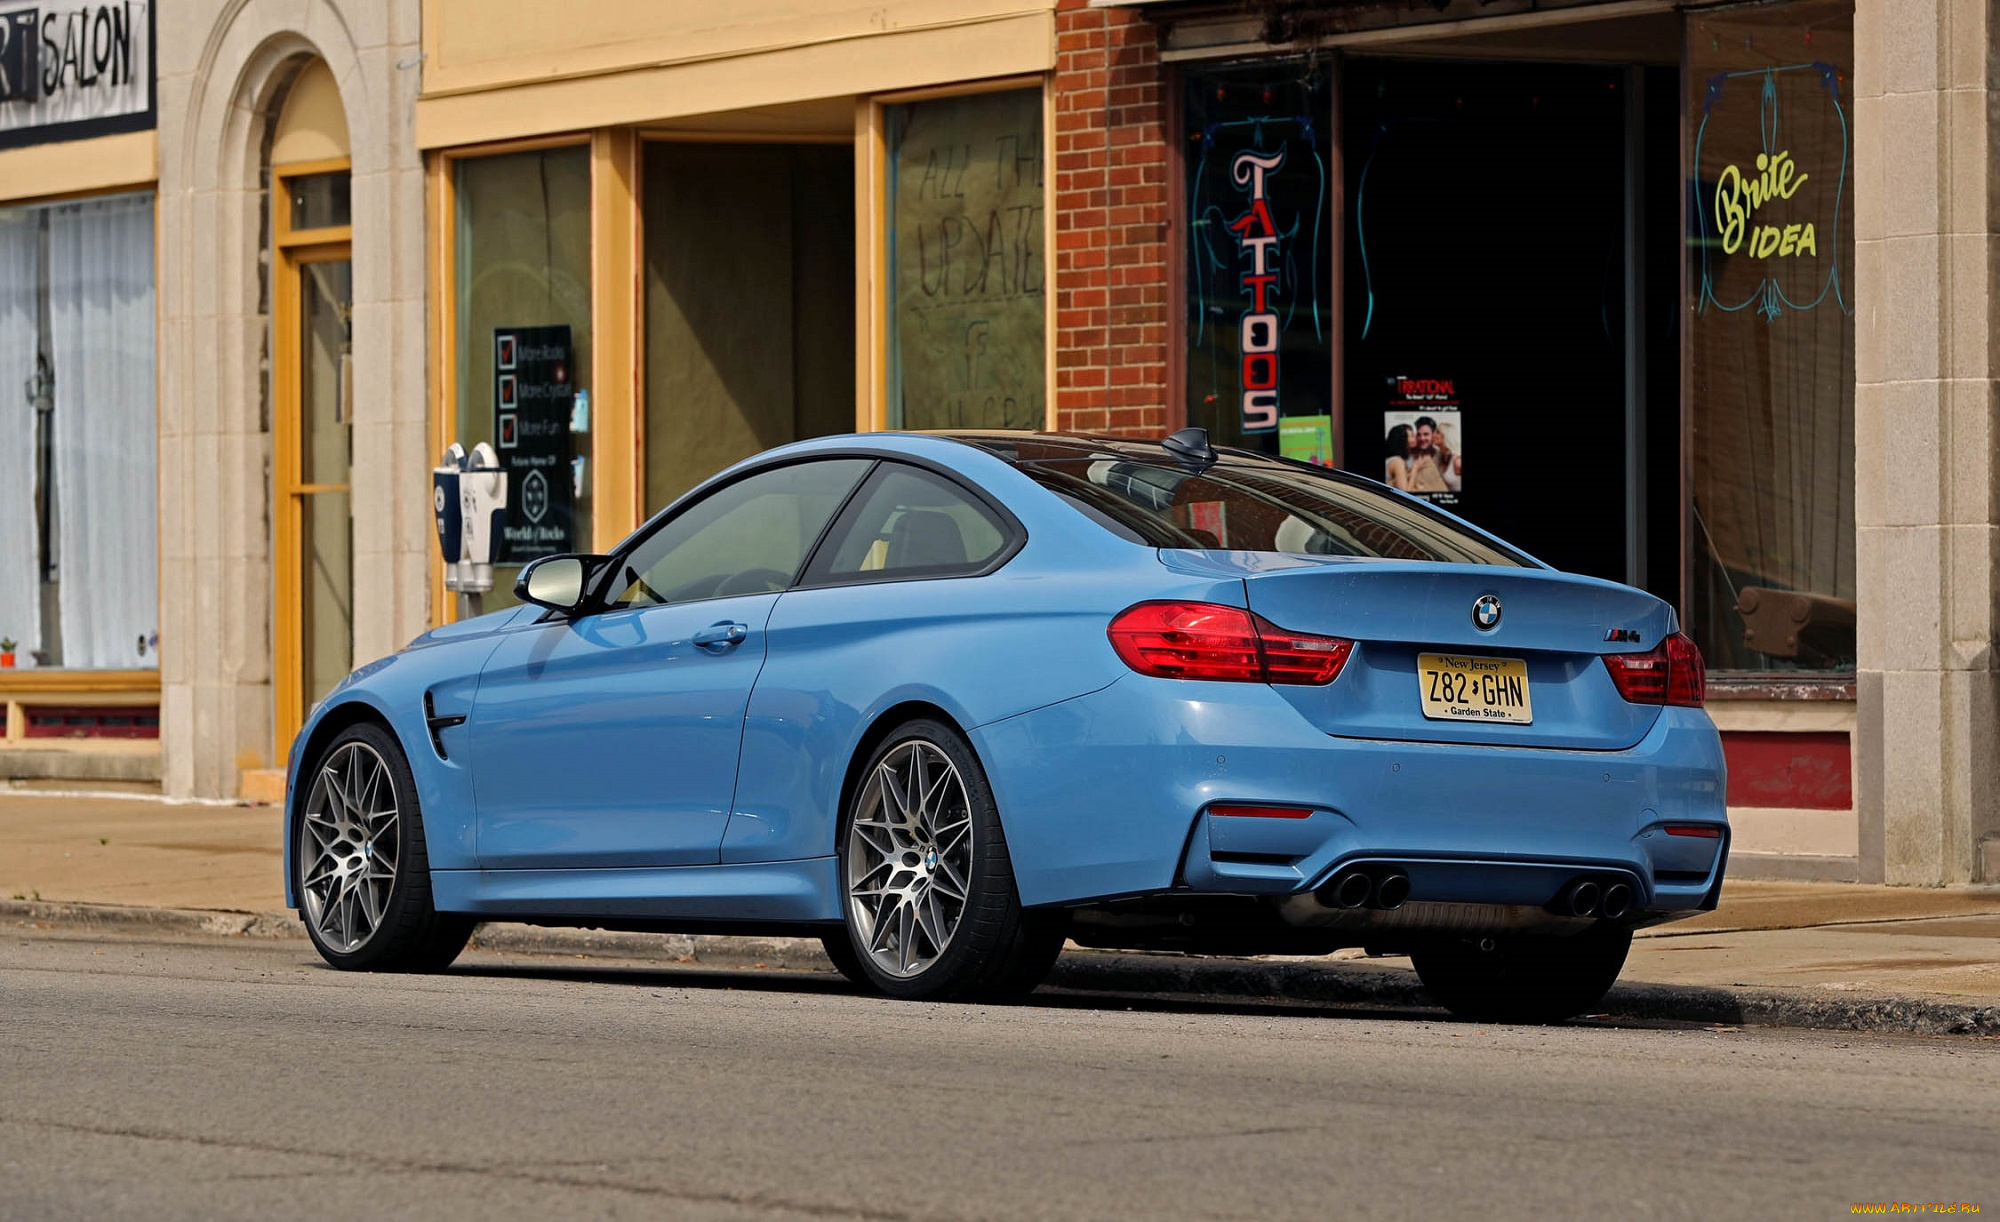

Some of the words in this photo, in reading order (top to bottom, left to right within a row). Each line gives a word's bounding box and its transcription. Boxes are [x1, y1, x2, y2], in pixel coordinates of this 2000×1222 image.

[42, 1, 130, 97] SALON
[919, 144, 970, 200] ALL
[1715, 150, 1808, 255] Brite
[1749, 223, 1816, 259] IDEA
[1231, 152, 1284, 430] TATTOOS
[504, 525, 532, 540] World
[1445, 657, 1468, 668] New
[1470, 659, 1500, 672] Jersey
[1427, 671, 1469, 704] Z82
[1482, 675, 1523, 707] GHN
[1451, 706, 1480, 717] Garden
[1483, 708, 1506, 718] State
